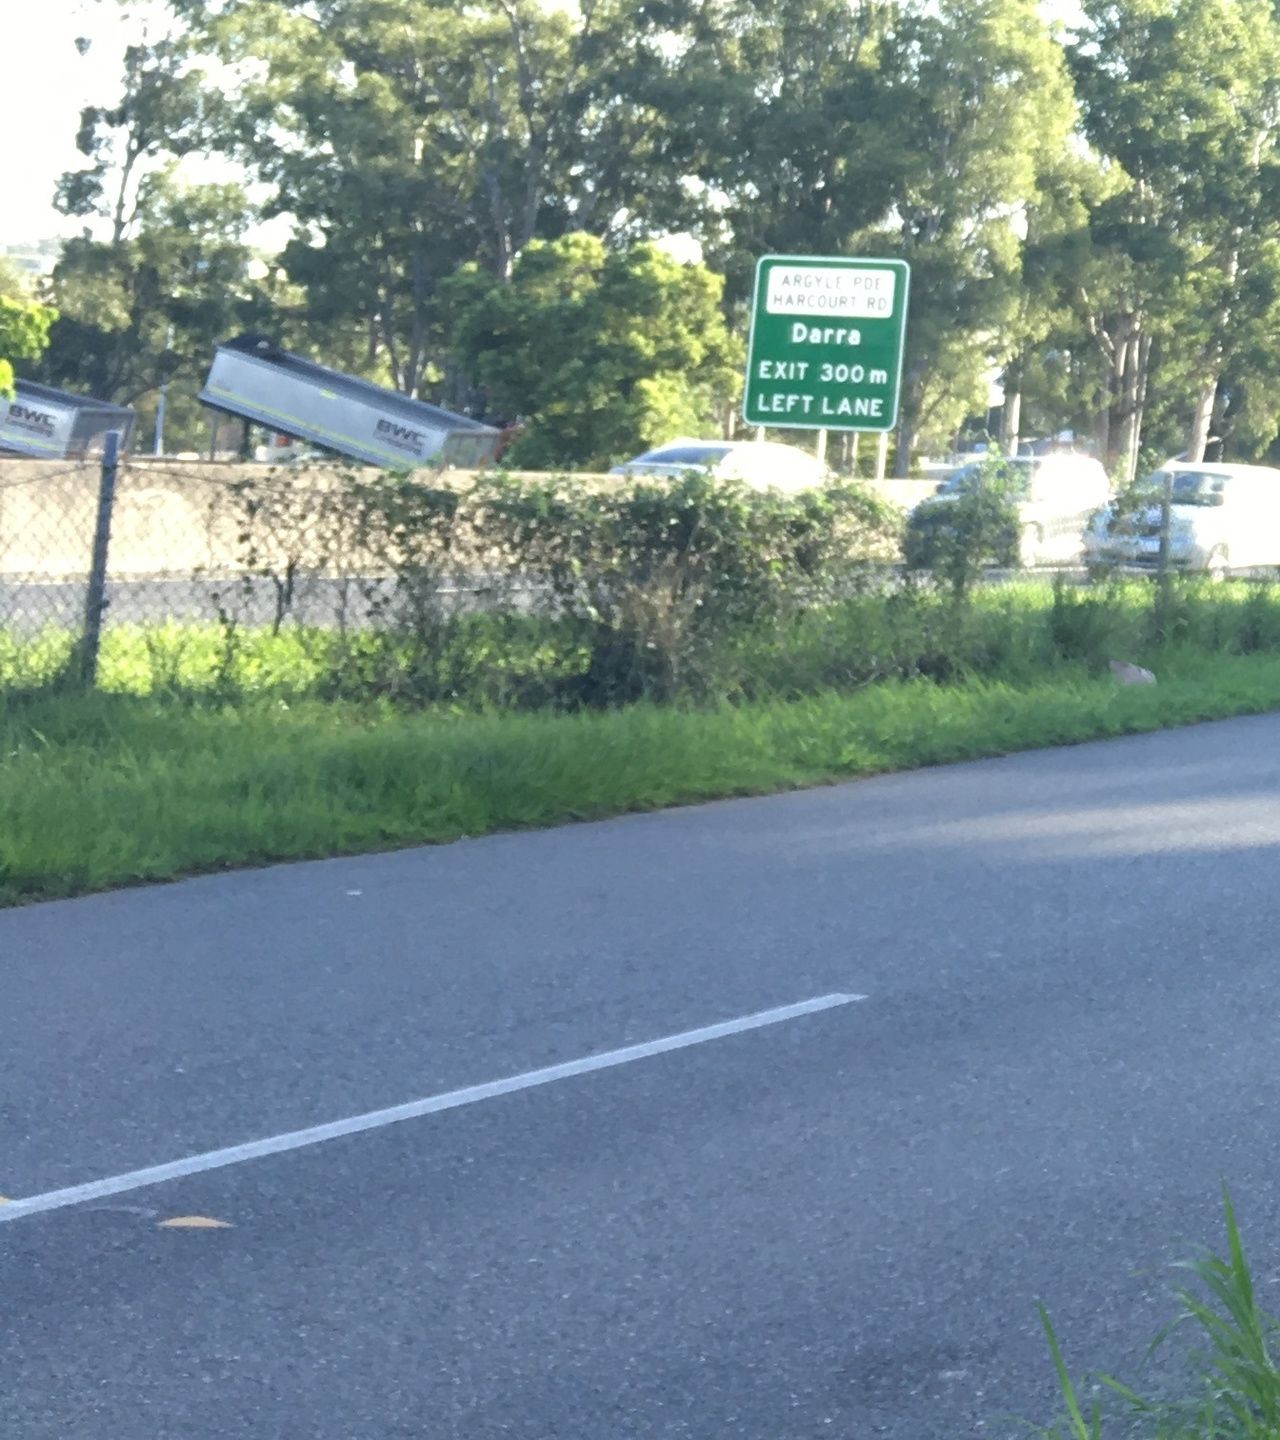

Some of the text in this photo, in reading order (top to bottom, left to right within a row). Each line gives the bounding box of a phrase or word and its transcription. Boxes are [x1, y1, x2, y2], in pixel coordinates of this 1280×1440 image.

[781, 274, 881, 291] ARGYLE PDE
[773, 293, 888, 311] HARCOURT RD
[791, 322, 862, 346] Darra
[758, 360, 809, 380] EXIT
[757, 393, 884, 417] LEFT LANE
